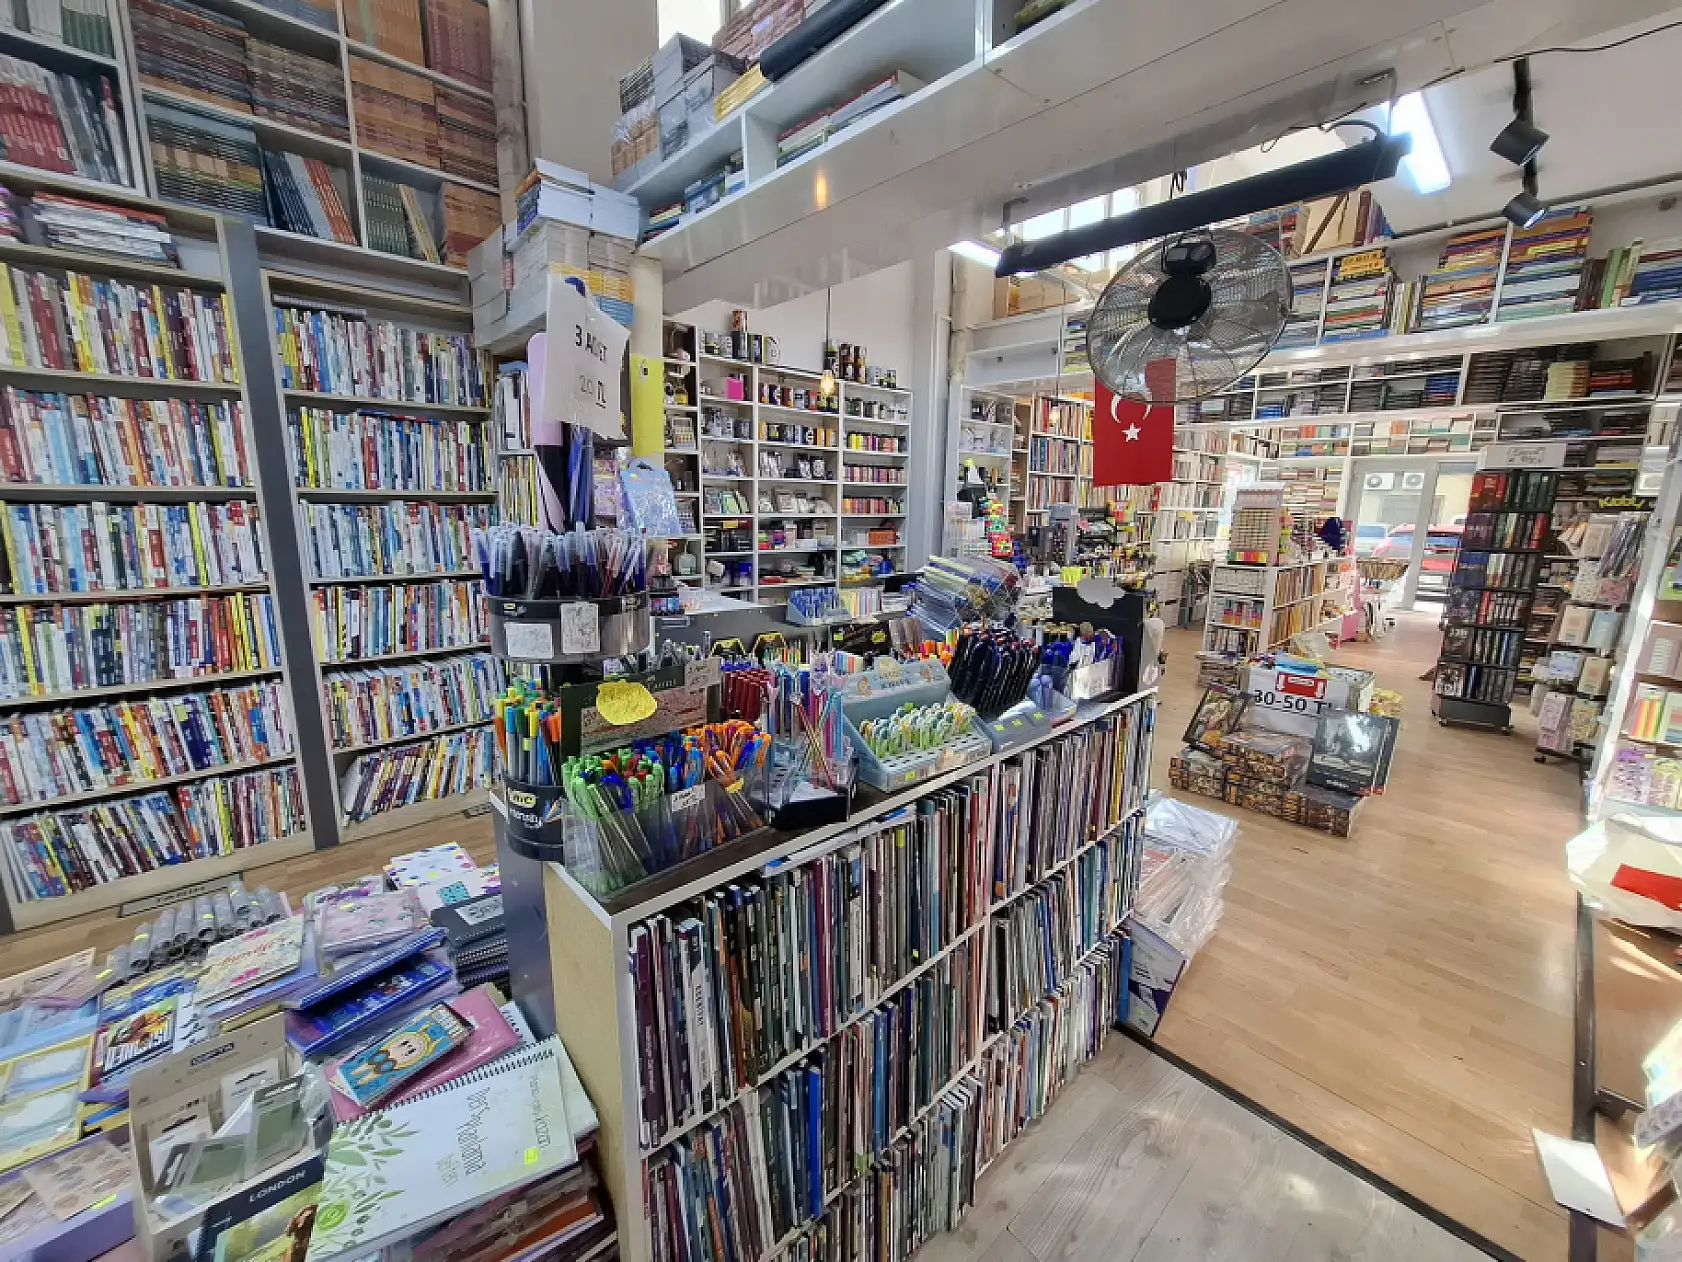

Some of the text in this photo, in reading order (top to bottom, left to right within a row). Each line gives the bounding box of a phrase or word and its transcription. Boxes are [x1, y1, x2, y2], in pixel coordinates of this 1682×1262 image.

[574, 324, 582, 347] 3
[1254, 689, 1308, 712] 30-50
[249, 1169, 307, 1203] LONDON
